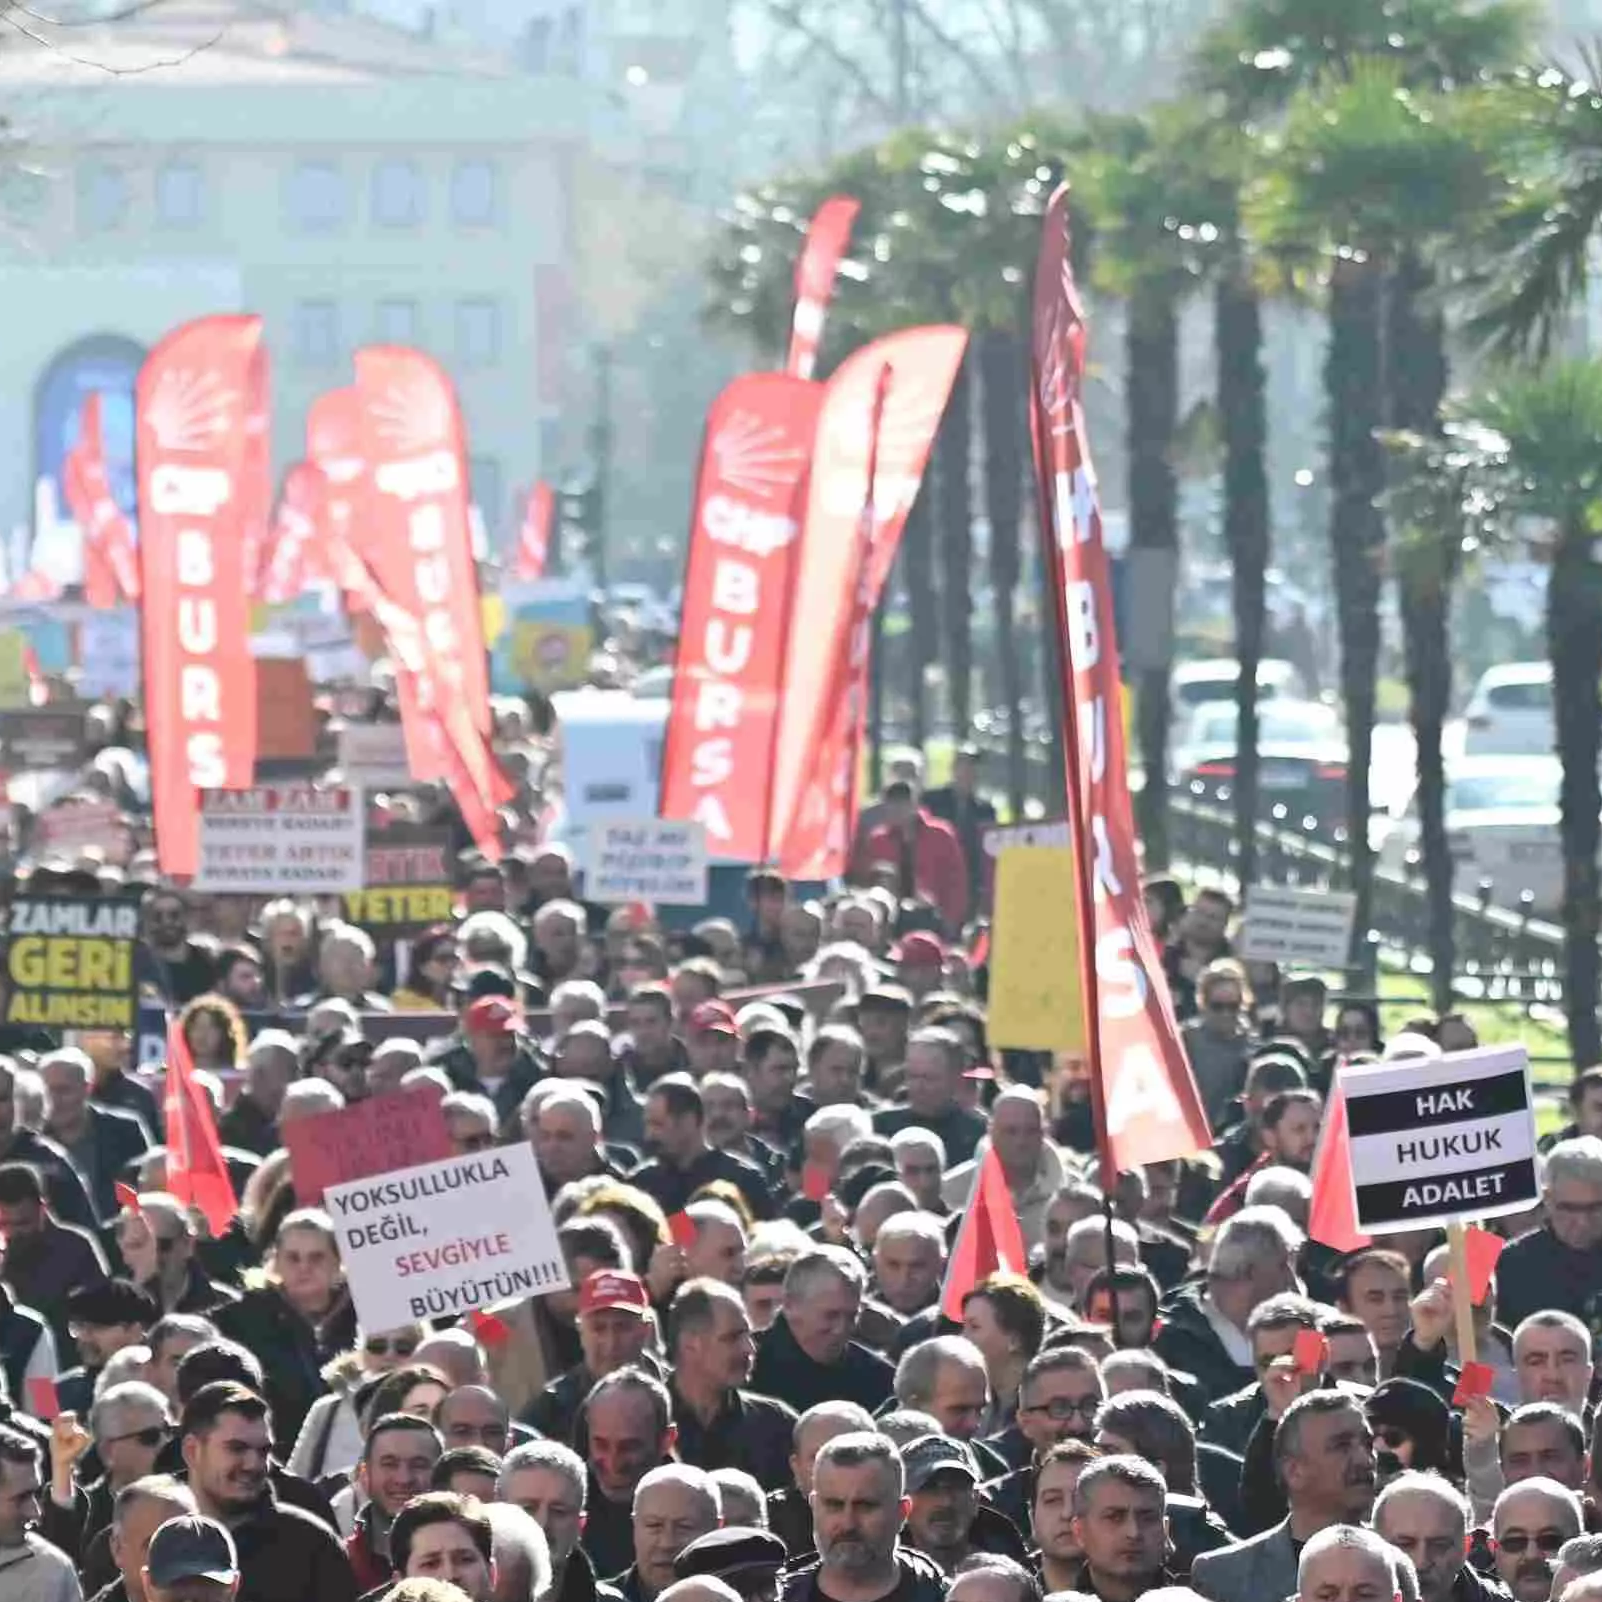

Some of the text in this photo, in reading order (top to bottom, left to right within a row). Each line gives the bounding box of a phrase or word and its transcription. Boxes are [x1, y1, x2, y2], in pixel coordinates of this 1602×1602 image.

[177, 529, 227, 788] BURS
[10, 902, 138, 936] ZAMLAR
[7, 991, 132, 1026] ALINSIN
[1416, 1089, 1474, 1116] HAK
[1397, 1128, 1502, 1164] HUKUK
[335, 1158, 509, 1215] YOKSULLUKLA
[1402, 1173, 1505, 1208] ADALET
[348, 1212, 428, 1250] DEĞİL,
[395, 1234, 512, 1277] SEVGİYLE
[410, 1261, 561, 1318] BÜYÜTÜN!!!
